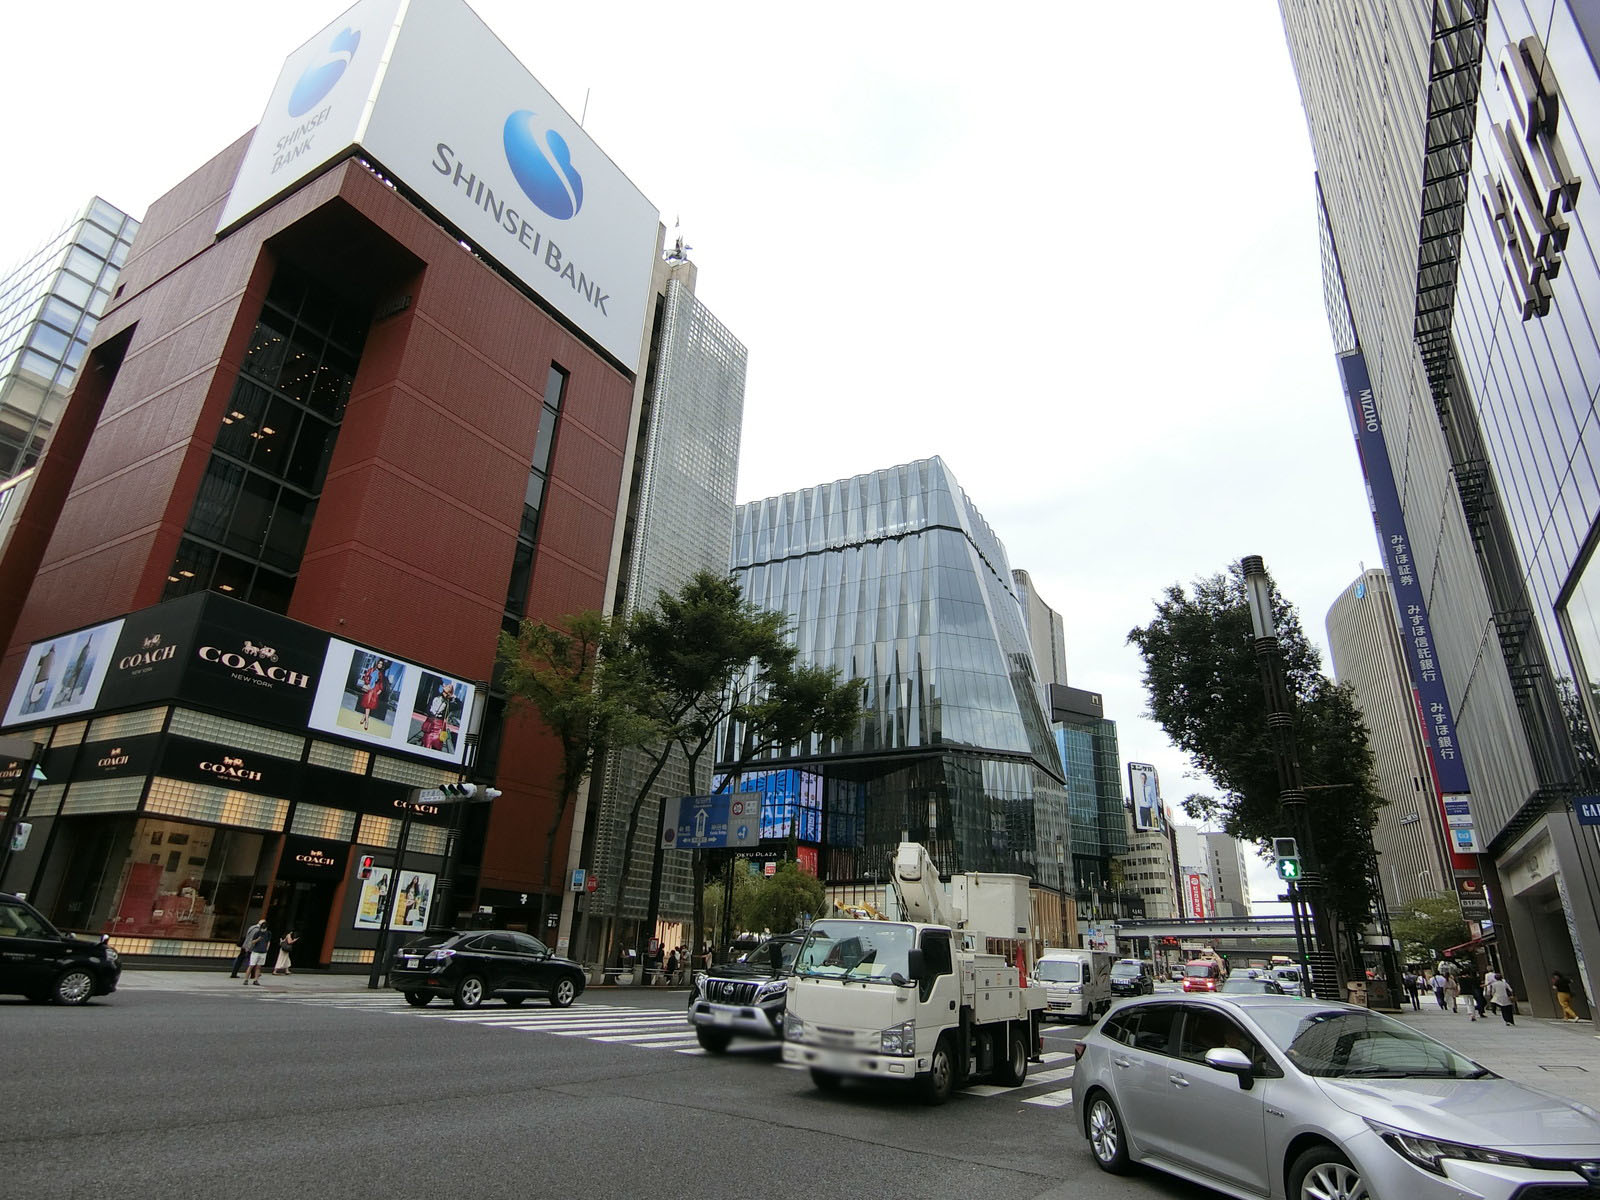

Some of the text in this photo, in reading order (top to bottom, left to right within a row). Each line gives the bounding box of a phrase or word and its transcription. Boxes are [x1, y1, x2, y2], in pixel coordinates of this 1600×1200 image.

[273, 105, 332, 157] SHINSEI
[271, 135, 315, 175] BANK
[432, 142, 609, 317] SHINSEI BANK
[1359, 389, 1378, 432] MIZUHO
[1391, 534, 1414, 586] みずほ証券
[119, 645, 177, 670] COACH
[1407, 605, 1437, 682] みずほ信託銀行
[198, 646, 310, 689] COACH
[231, 672, 273, 689] NEW YORK
[1430, 702, 1455, 760] みずほ銀行
[97, 755, 129, 767] COACH
[199, 761, 262, 781] COACH
[295, 854, 335, 866] COACH
